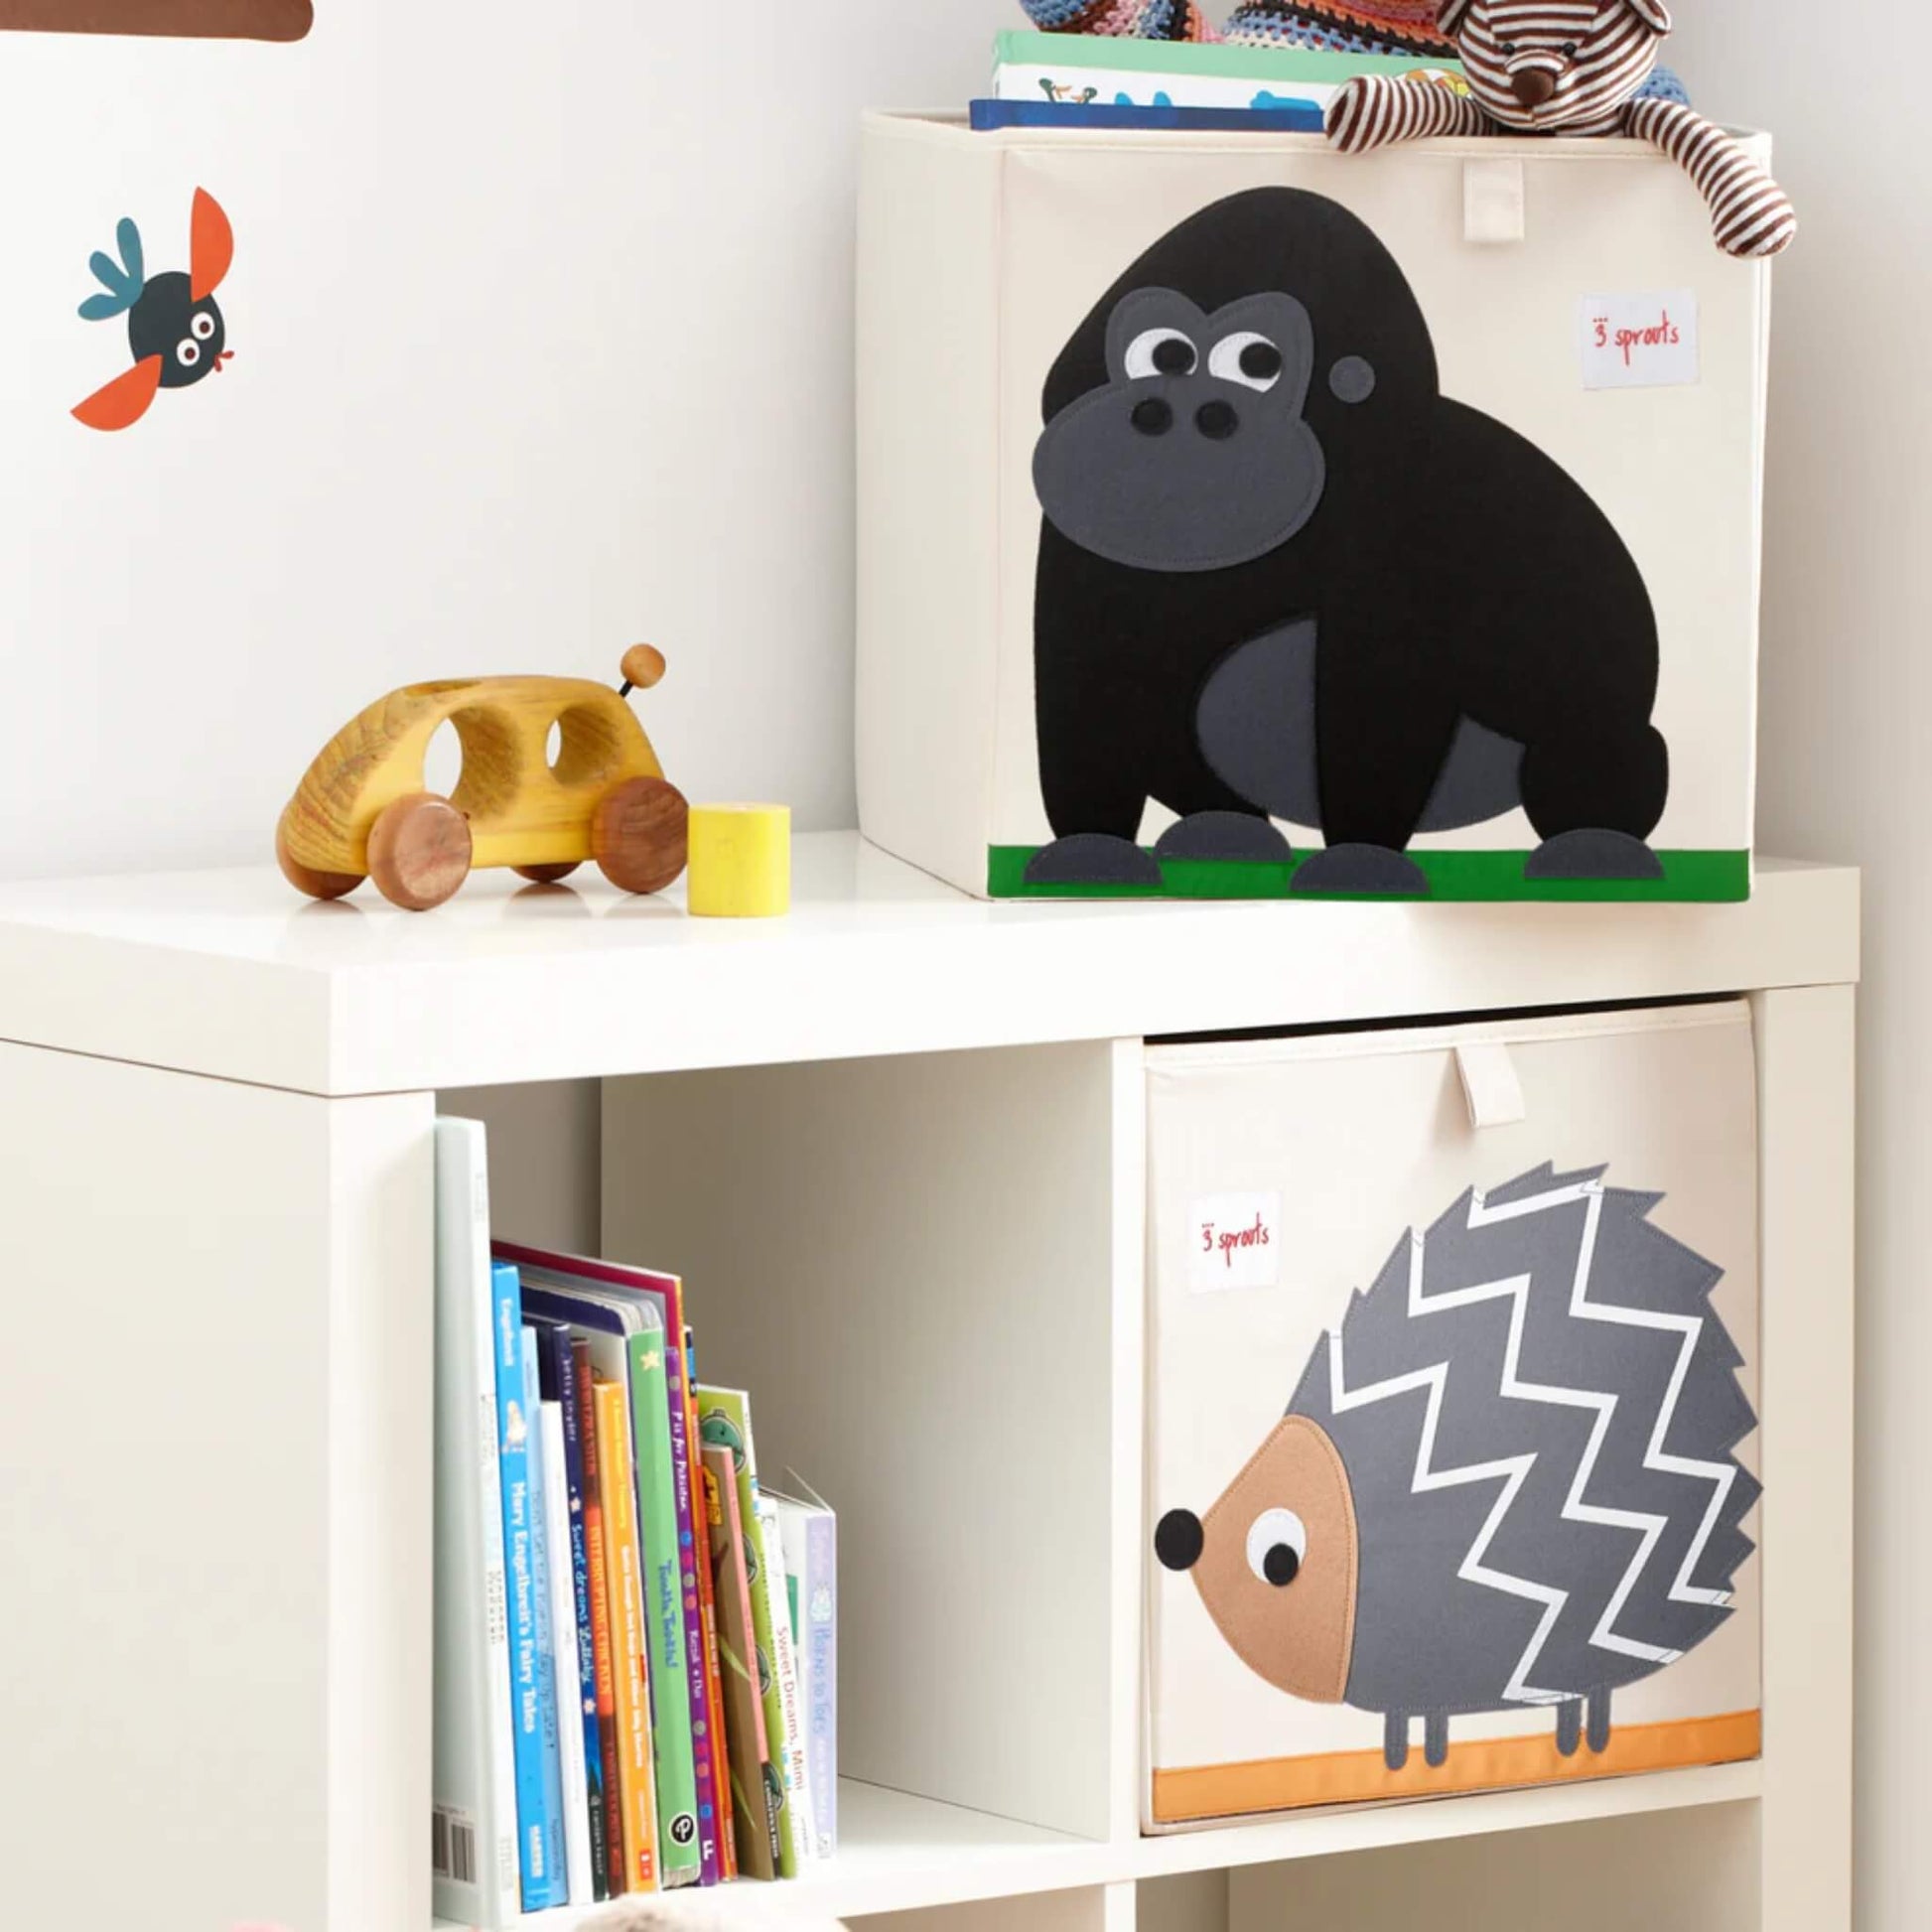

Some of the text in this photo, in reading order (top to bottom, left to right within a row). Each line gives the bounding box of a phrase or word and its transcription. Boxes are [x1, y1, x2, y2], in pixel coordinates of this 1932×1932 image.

[1615, 309, 1679, 365] sprouts
[1219, 1211, 1269, 1268] sprouts
[500, 1300, 514, 1366] Engelbreit
[672, 1412, 687, 1510] P is for Pakistan
[511, 1481, 537, 1733] Mary Engelbreit's Fairy Tales
[572, 1524, 594, 1684] Sweet dreams Lullaby
[590, 1525, 611, 1695] INTERRUPTING CHICKEN
[776, 1626, 792, 1676] Sweet
[784, 1681, 798, 1745] Dreams,
[791, 1749, 804, 1790] Mimi
